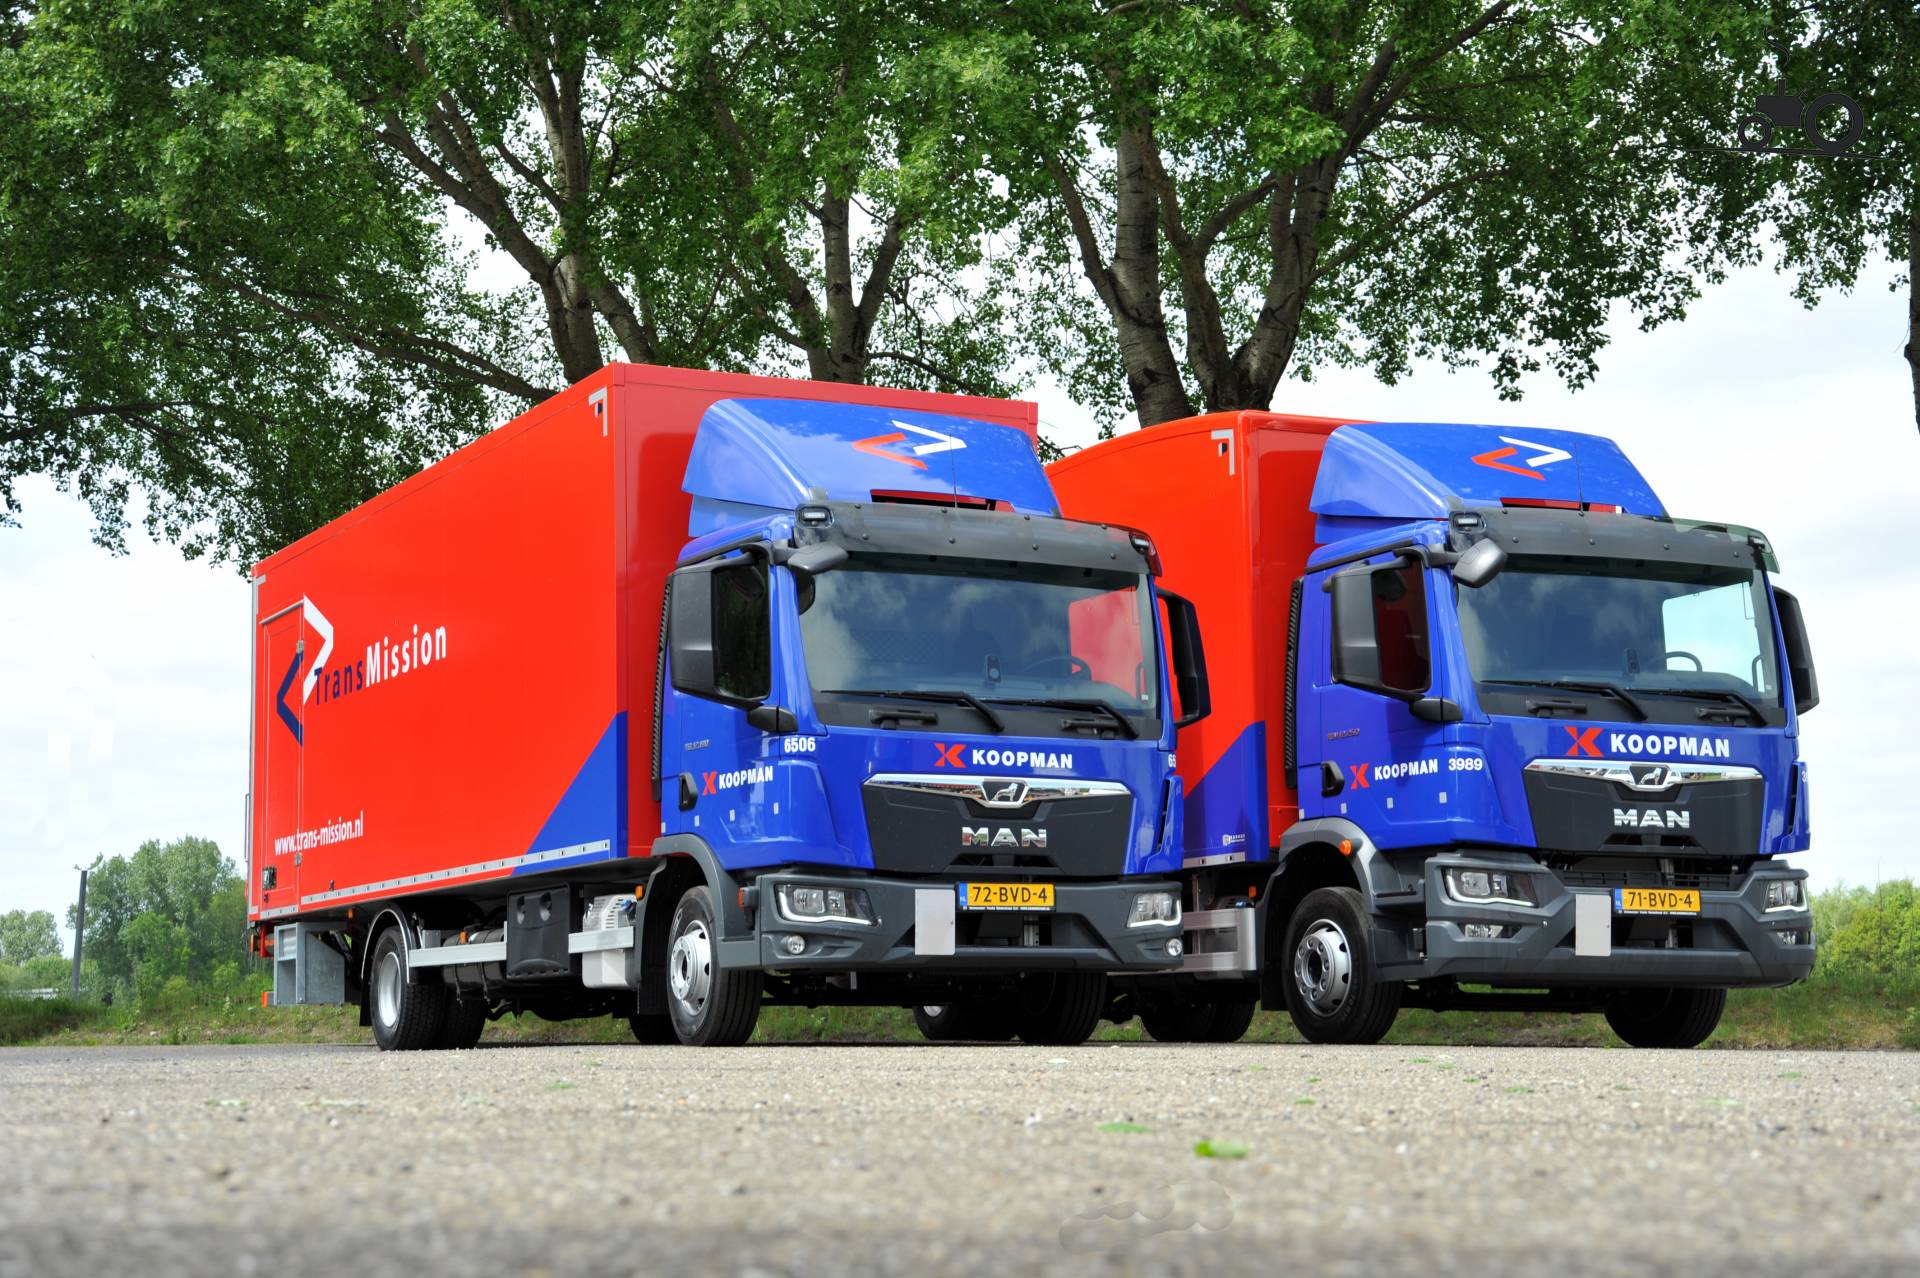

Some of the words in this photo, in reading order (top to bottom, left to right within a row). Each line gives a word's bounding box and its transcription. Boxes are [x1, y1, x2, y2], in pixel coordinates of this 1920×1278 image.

[313, 623, 447, 706] TransMission
[784, 737, 816, 753] 6506
[1610, 733, 1730, 758] KOOPMAN
[971, 749, 1073, 769] KOOPMAN
[1374, 758, 1439, 781] KOOPMAN
[1448, 757, 1483, 771] 3989
[718, 765, 774, 790] KOOPMAN
[1613, 808, 1690, 829] MAN
[274, 809, 364, 856] www.trans-mission.nl
[961, 826, 1047, 848] MAN
[972, 886, 1048, 903] 72-BVD-4
[1628, 891, 1693, 909] 71-BVD-4
